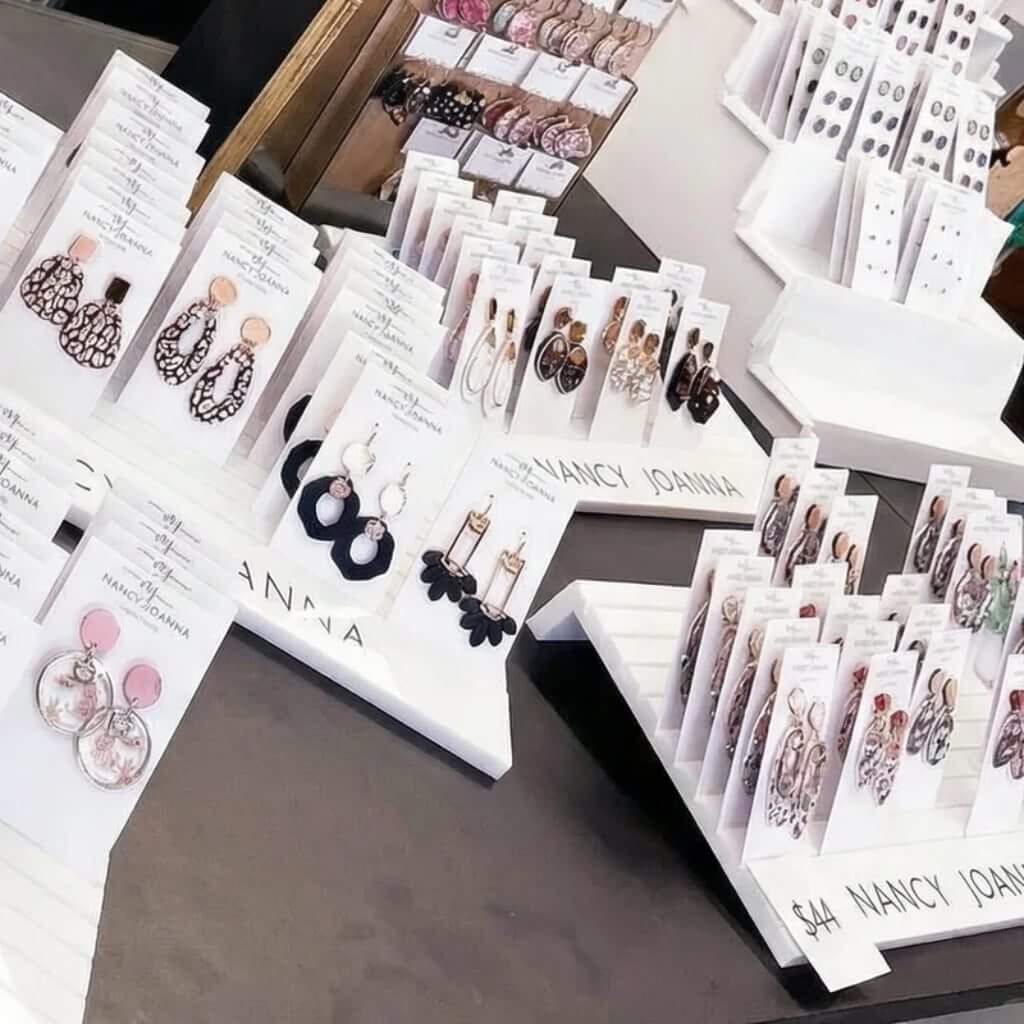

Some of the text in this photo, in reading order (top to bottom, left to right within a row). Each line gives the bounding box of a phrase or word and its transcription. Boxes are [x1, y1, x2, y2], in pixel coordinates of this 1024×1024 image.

[643, 467, 745, 498] JOANNA
[102, 572, 145, 604] NANCY
[140, 603, 190, 639] JOANNA
[845, 863, 1024, 918] NANCY JOAN
[792, 898, 842, 941] $44
